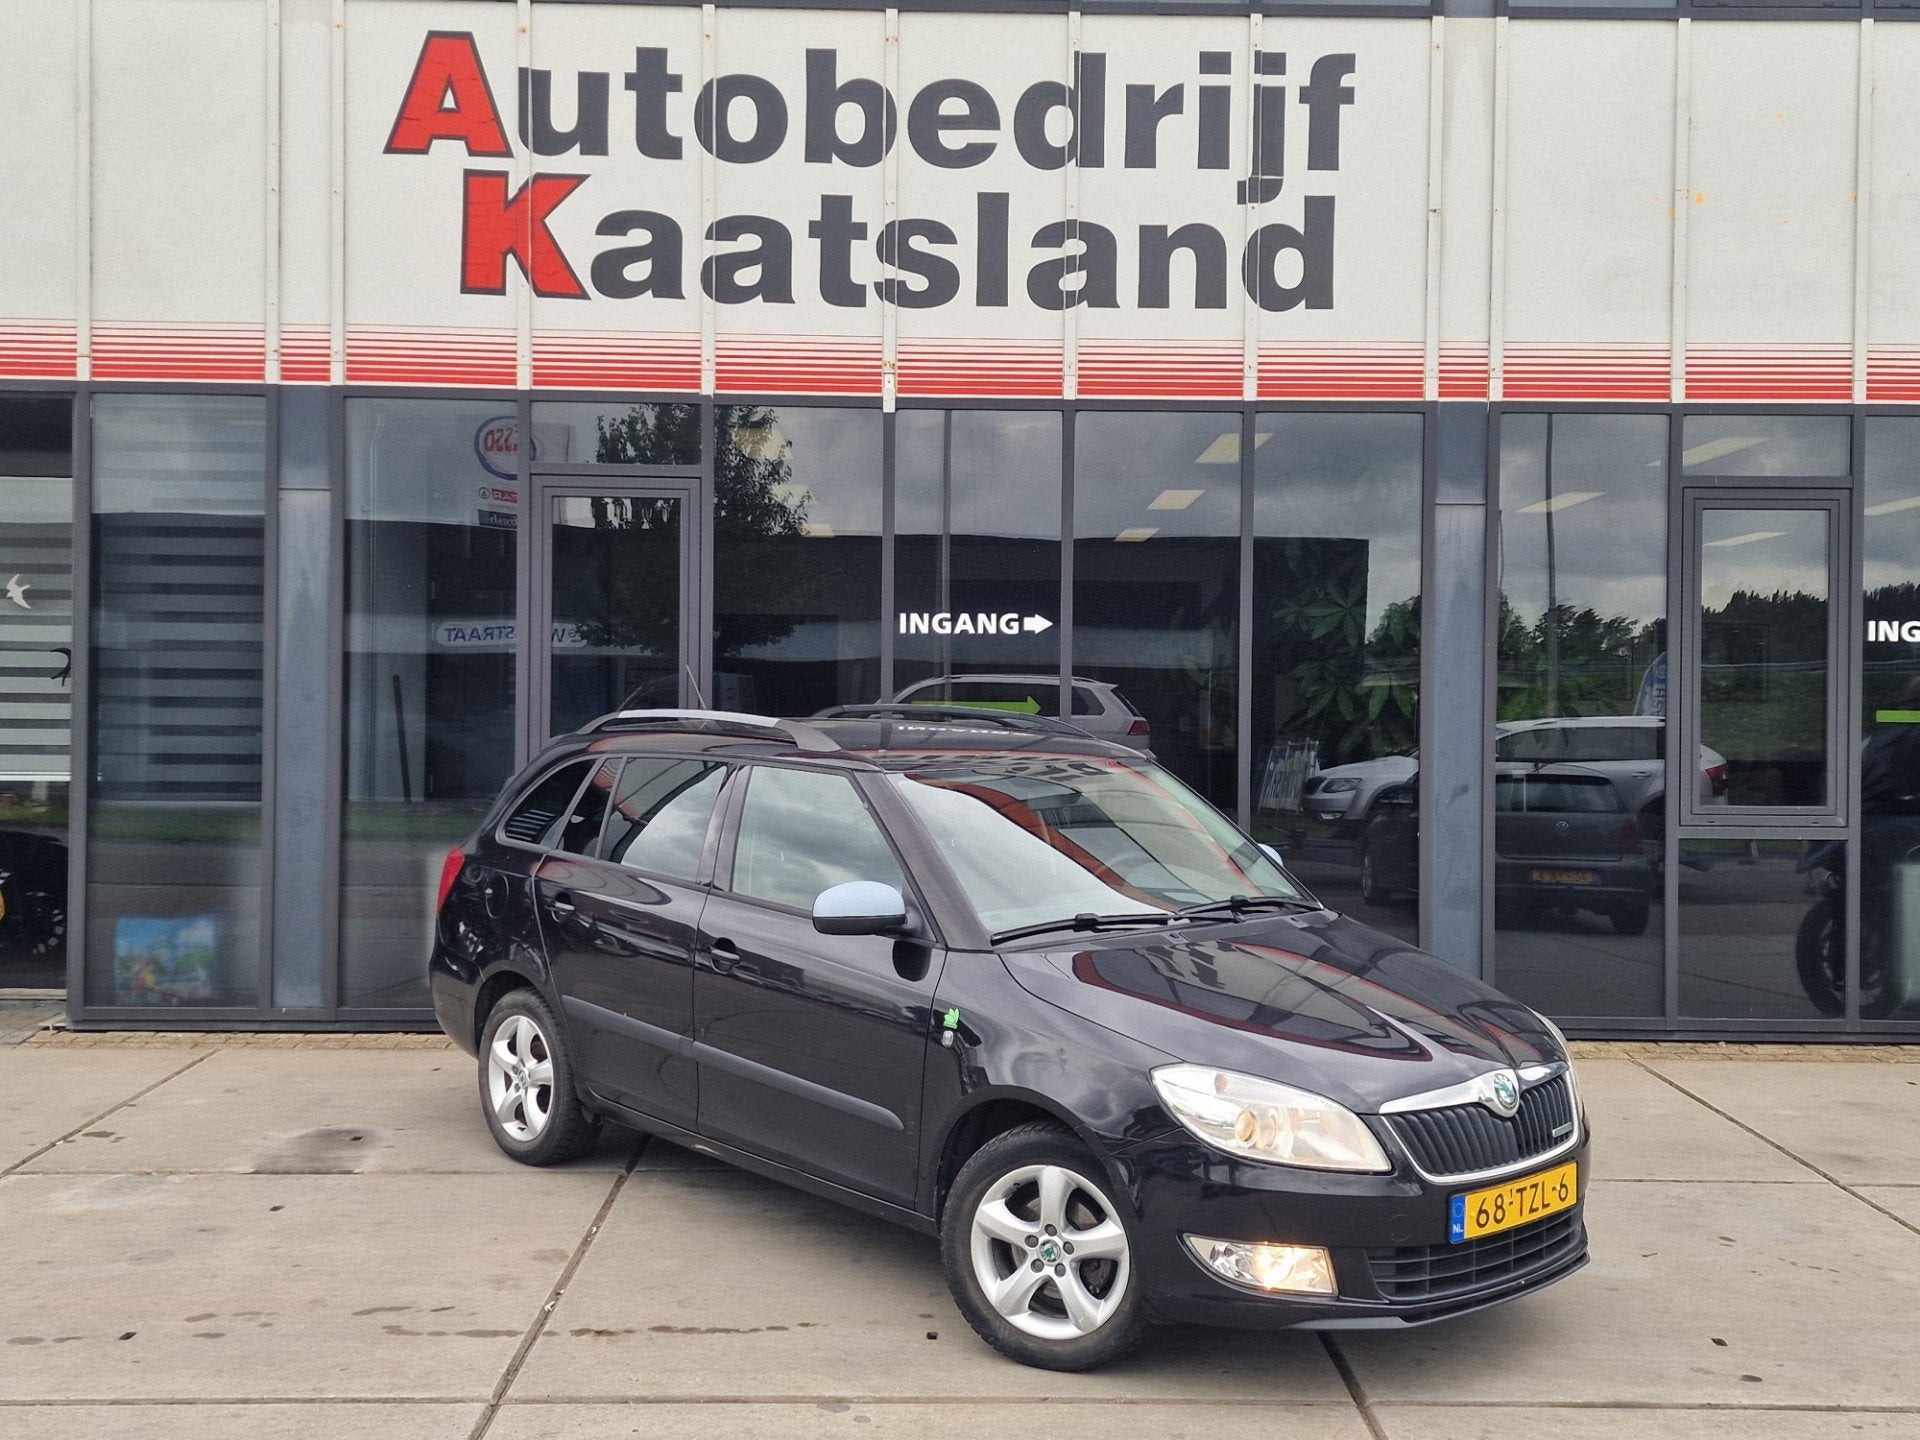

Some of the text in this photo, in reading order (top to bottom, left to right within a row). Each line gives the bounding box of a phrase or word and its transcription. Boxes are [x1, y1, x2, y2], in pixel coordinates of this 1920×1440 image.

[384, 31, 1356, 204] Autobedrijf
[460, 168, 1335, 311] Kaatsland
[899, 612, 1020, 635] INGANG
[1452, 1223, 1464, 1234] NL
[1475, 1172, 1569, 1229] 68-TZL-6
